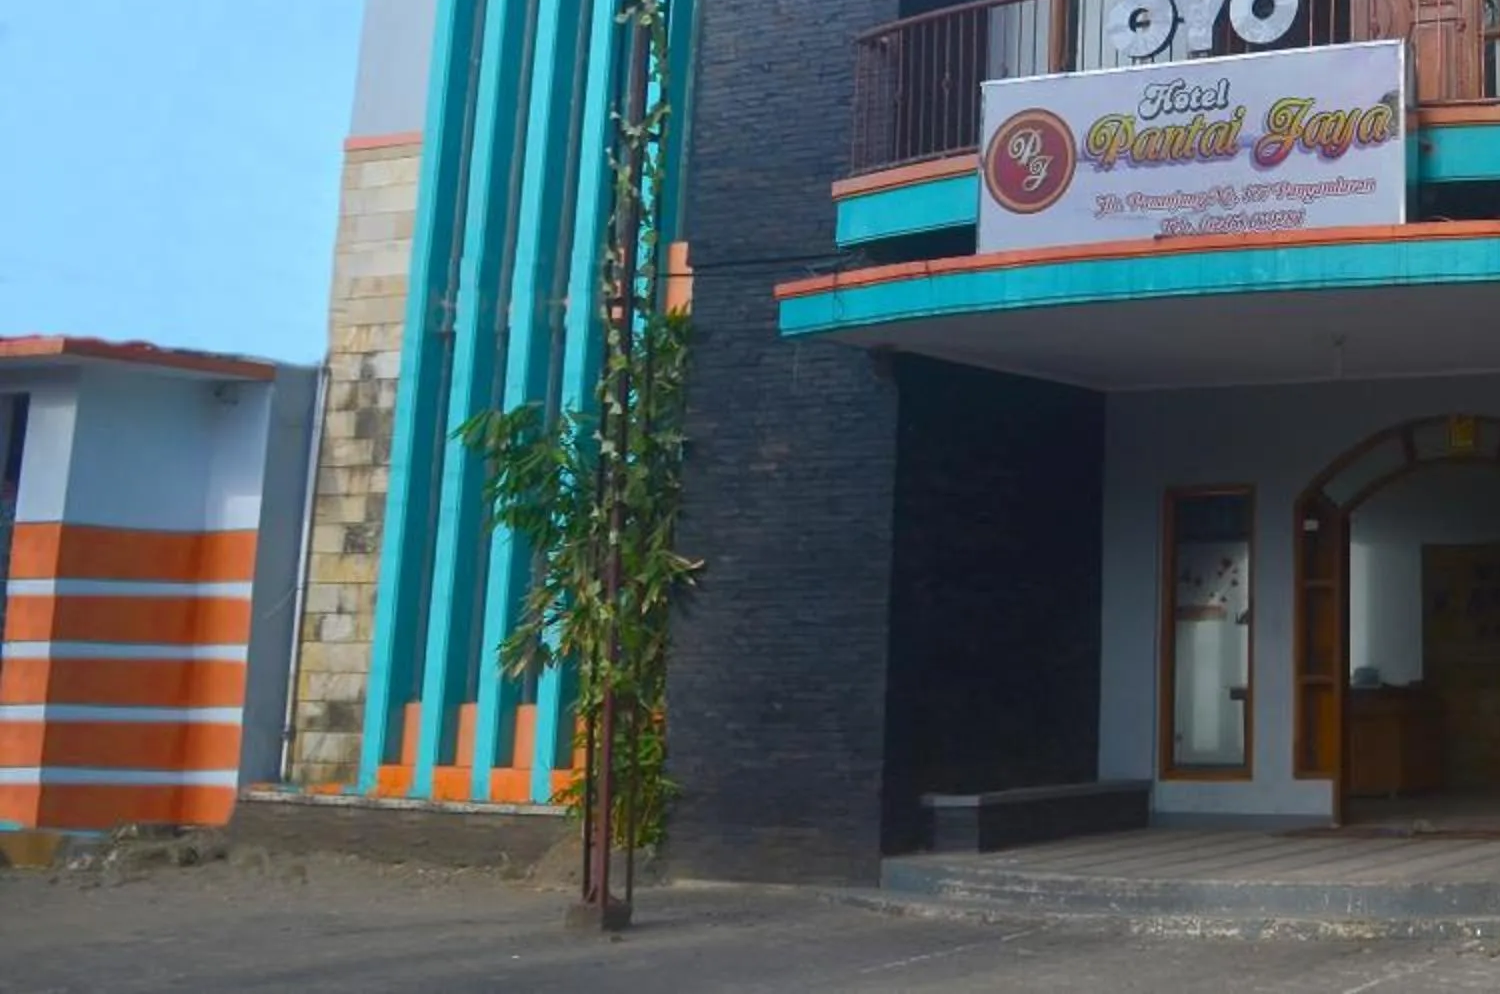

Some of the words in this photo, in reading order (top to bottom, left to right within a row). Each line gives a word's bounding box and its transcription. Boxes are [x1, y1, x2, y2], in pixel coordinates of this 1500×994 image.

[1138, 78, 1230, 120] Hotel
[1086, 106, 1248, 169] Pantai
[1254, 97, 1394, 168] Jaya
